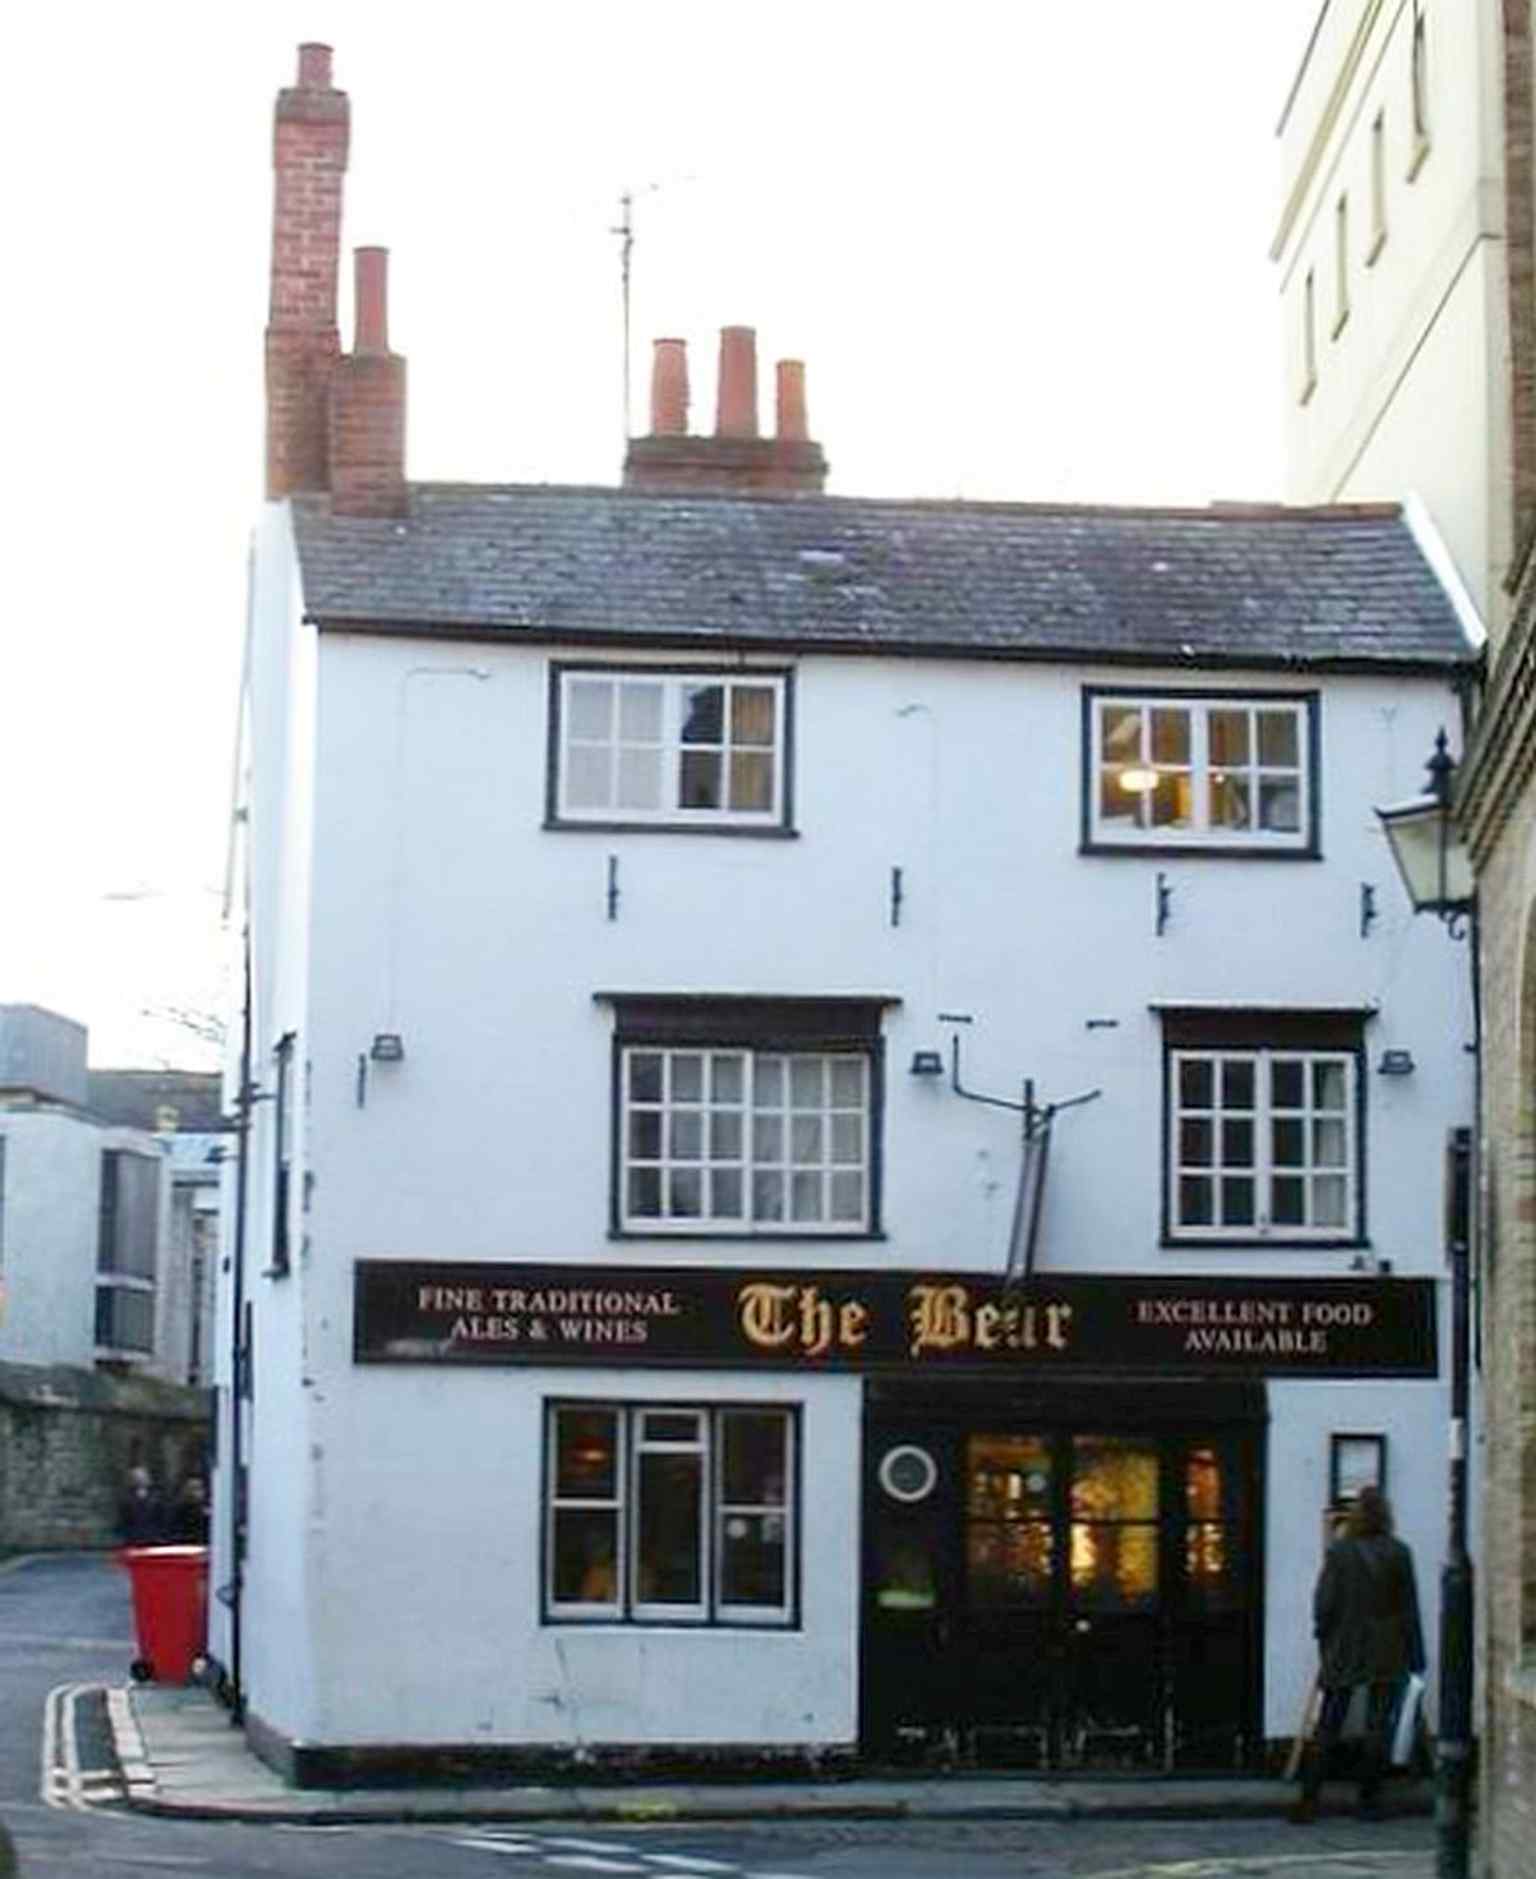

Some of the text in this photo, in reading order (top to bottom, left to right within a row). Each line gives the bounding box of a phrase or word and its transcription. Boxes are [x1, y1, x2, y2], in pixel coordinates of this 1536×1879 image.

[418, 1286, 680, 1316] FINE TRADITIONAL
[1138, 1299, 1373, 1326] EXCELLENT FOOD
[451, 1317, 648, 1344] ALES & WINES
[738, 1282, 1072, 1357] The Bear
[1185, 1328, 1327, 1352] AVAILABLE
